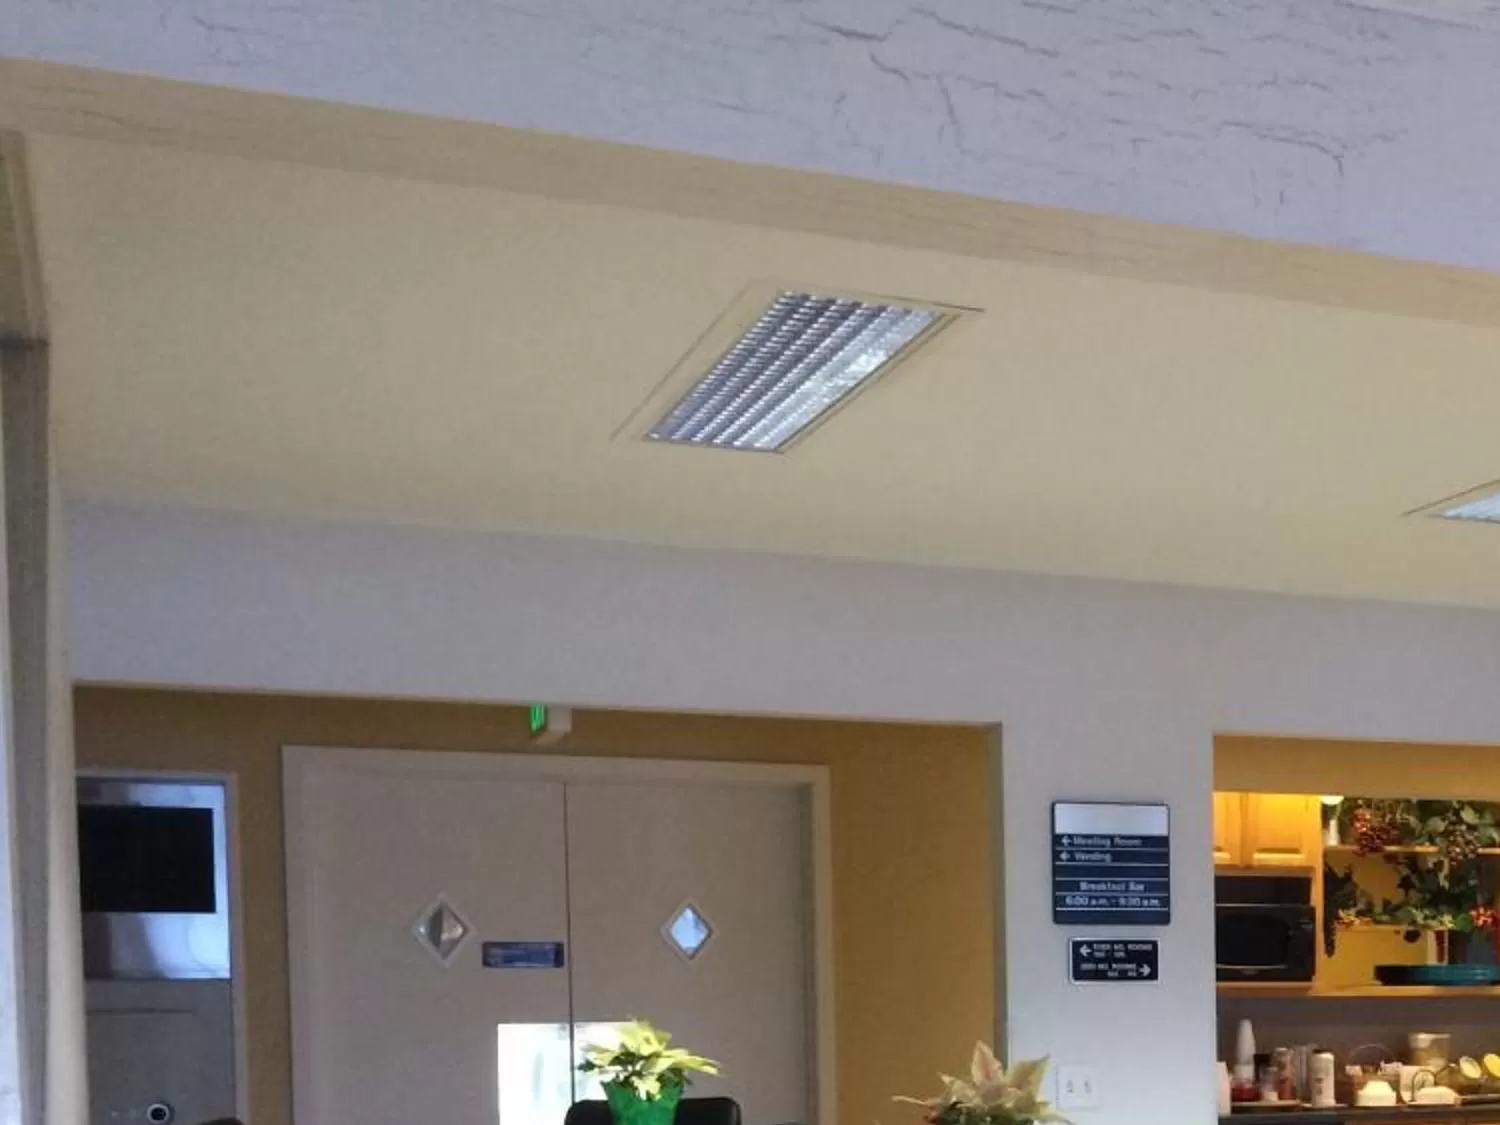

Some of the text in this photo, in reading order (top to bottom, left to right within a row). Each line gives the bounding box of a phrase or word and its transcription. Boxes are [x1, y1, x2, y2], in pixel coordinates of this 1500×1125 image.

[1073, 836, 1111, 848] Meeting
[1074, 852, 1112, 863] Vending
[1079, 881, 1125, 891] Breakfast
